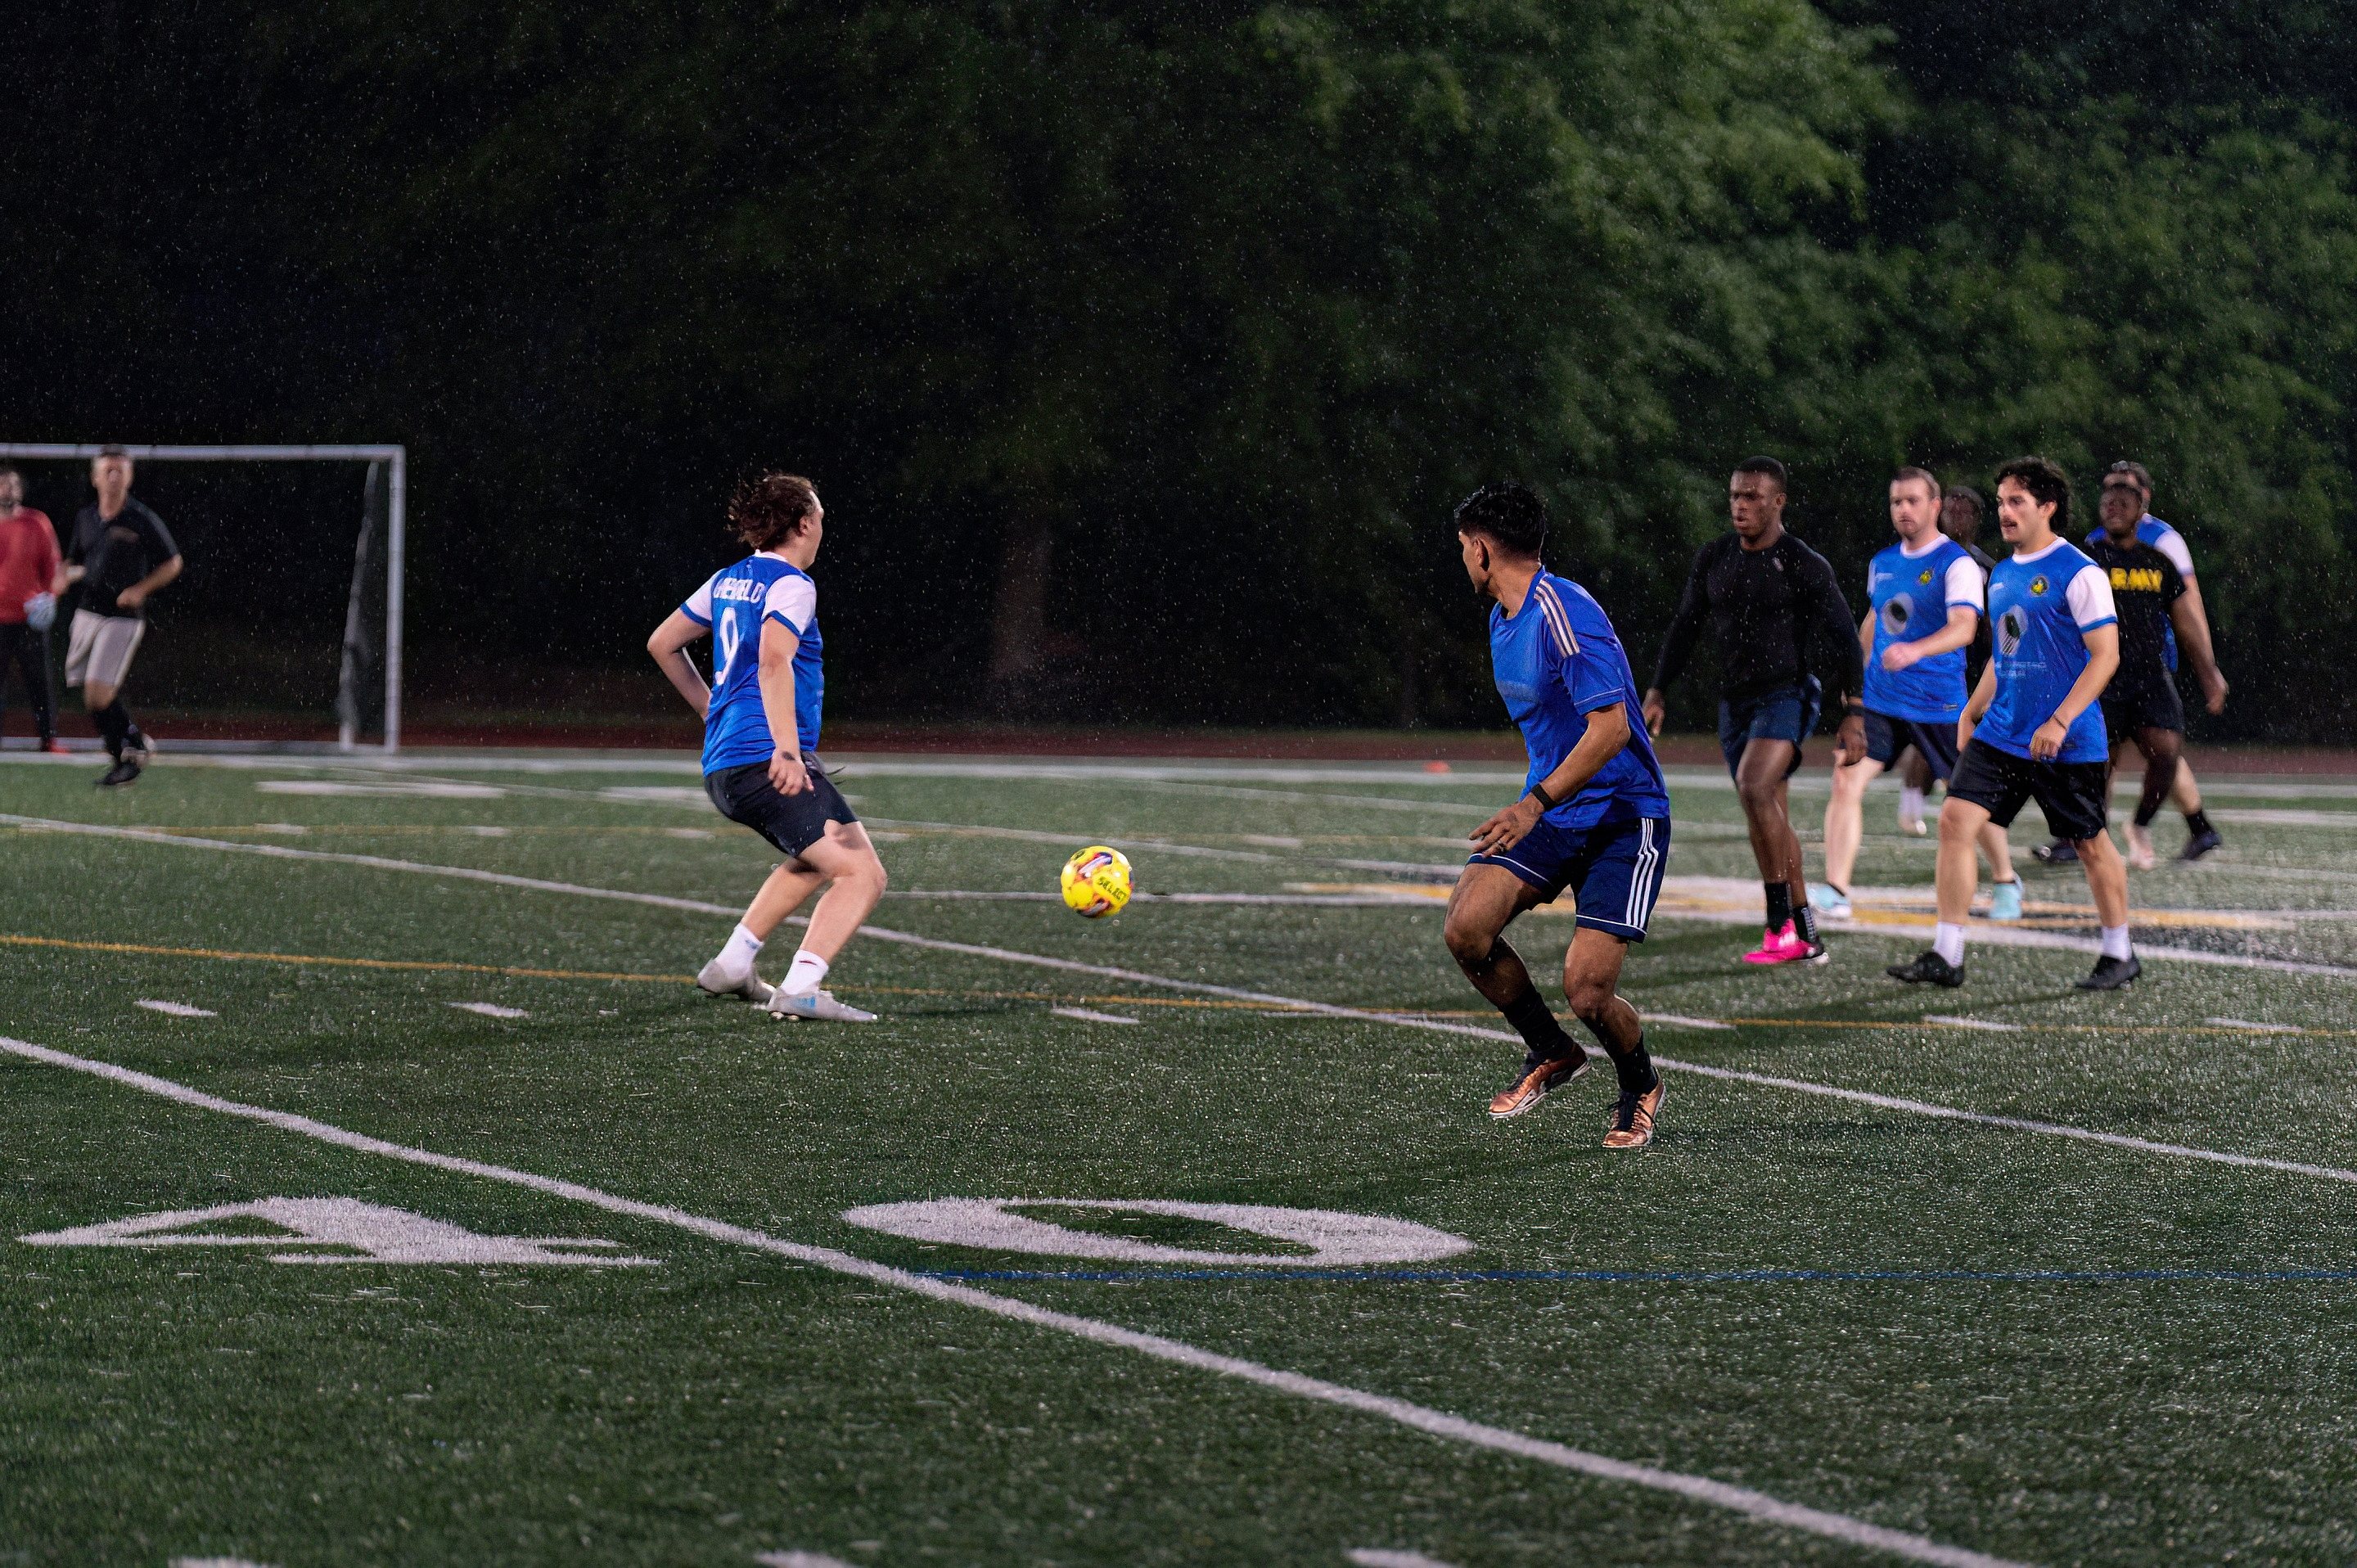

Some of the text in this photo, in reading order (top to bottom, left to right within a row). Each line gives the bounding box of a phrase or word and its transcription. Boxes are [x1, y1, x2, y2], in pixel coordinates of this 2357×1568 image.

[2110, 567, 2163, 593] RMY
[714, 607, 738, 685] 9
[1097, 876, 1127, 901] SELECT
